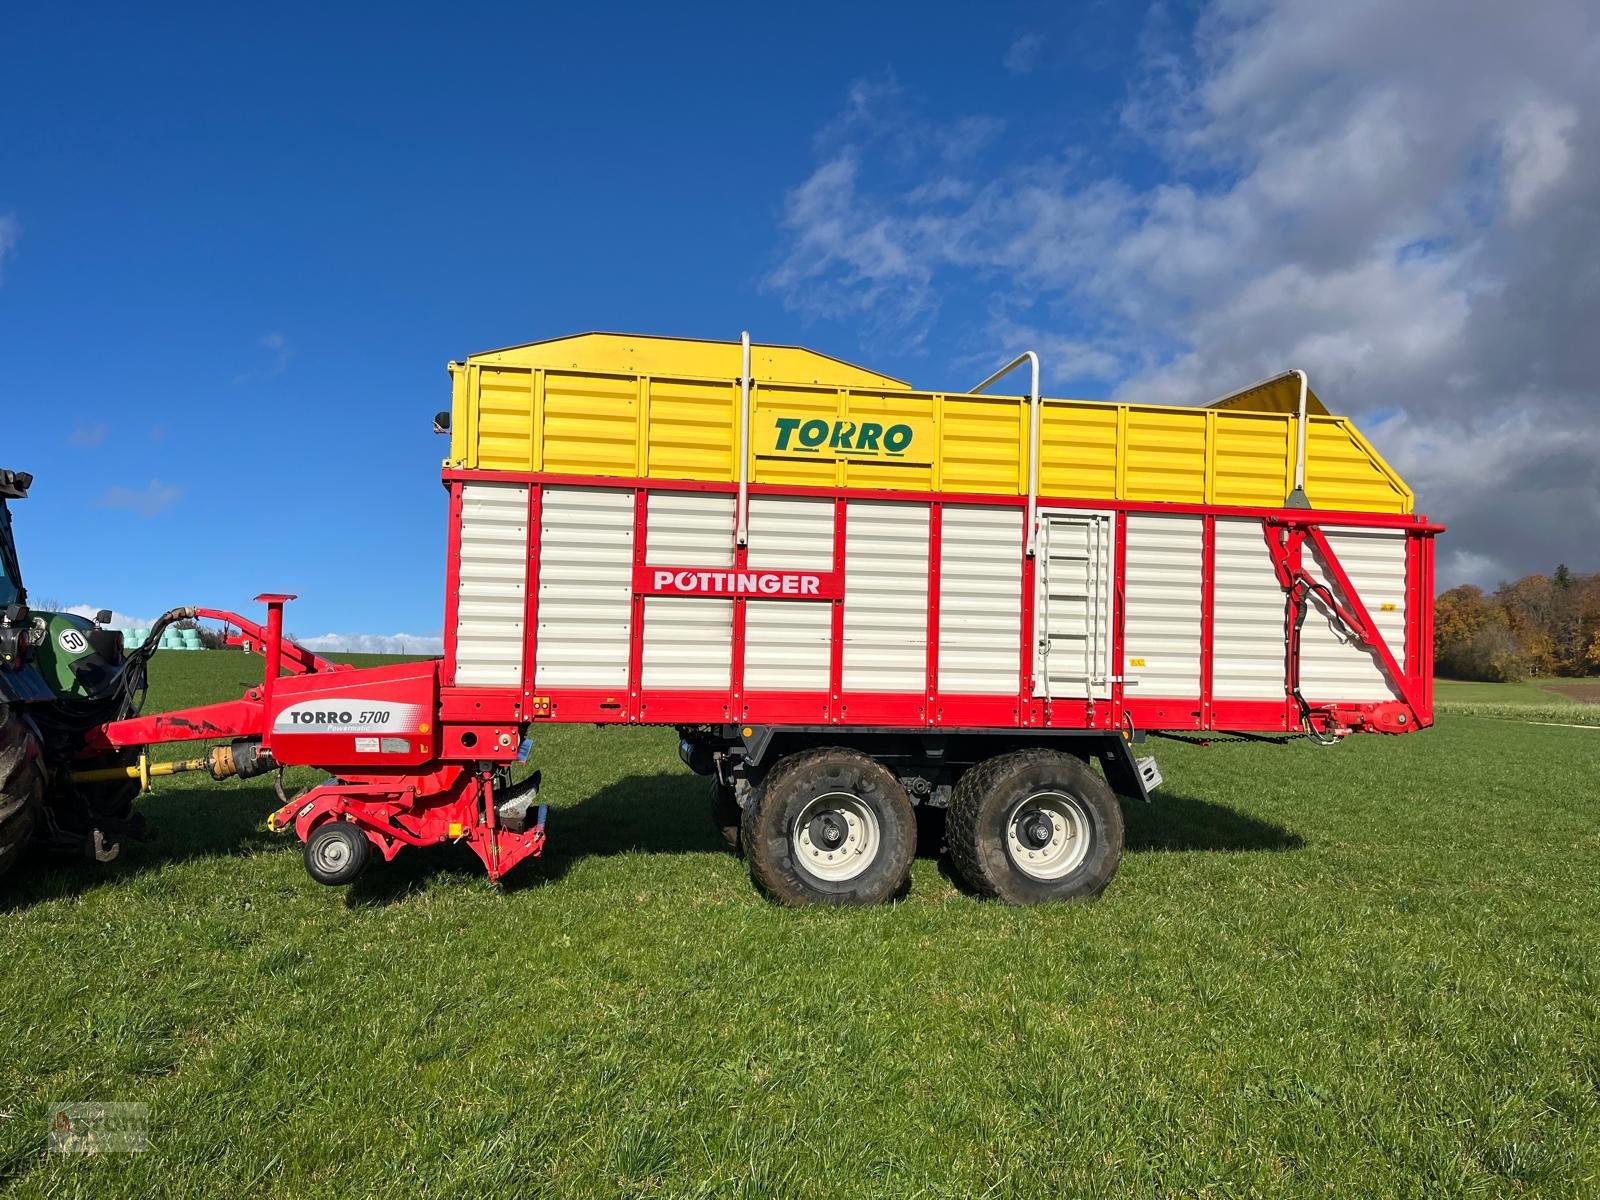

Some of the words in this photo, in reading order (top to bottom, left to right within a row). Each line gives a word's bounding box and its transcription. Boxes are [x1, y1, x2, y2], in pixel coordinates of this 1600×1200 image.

[775, 417, 913, 453] TORRO
[62, 632, 84, 650] 50
[290, 711, 353, 724] TORRO
[358, 711, 391, 724] 5700
